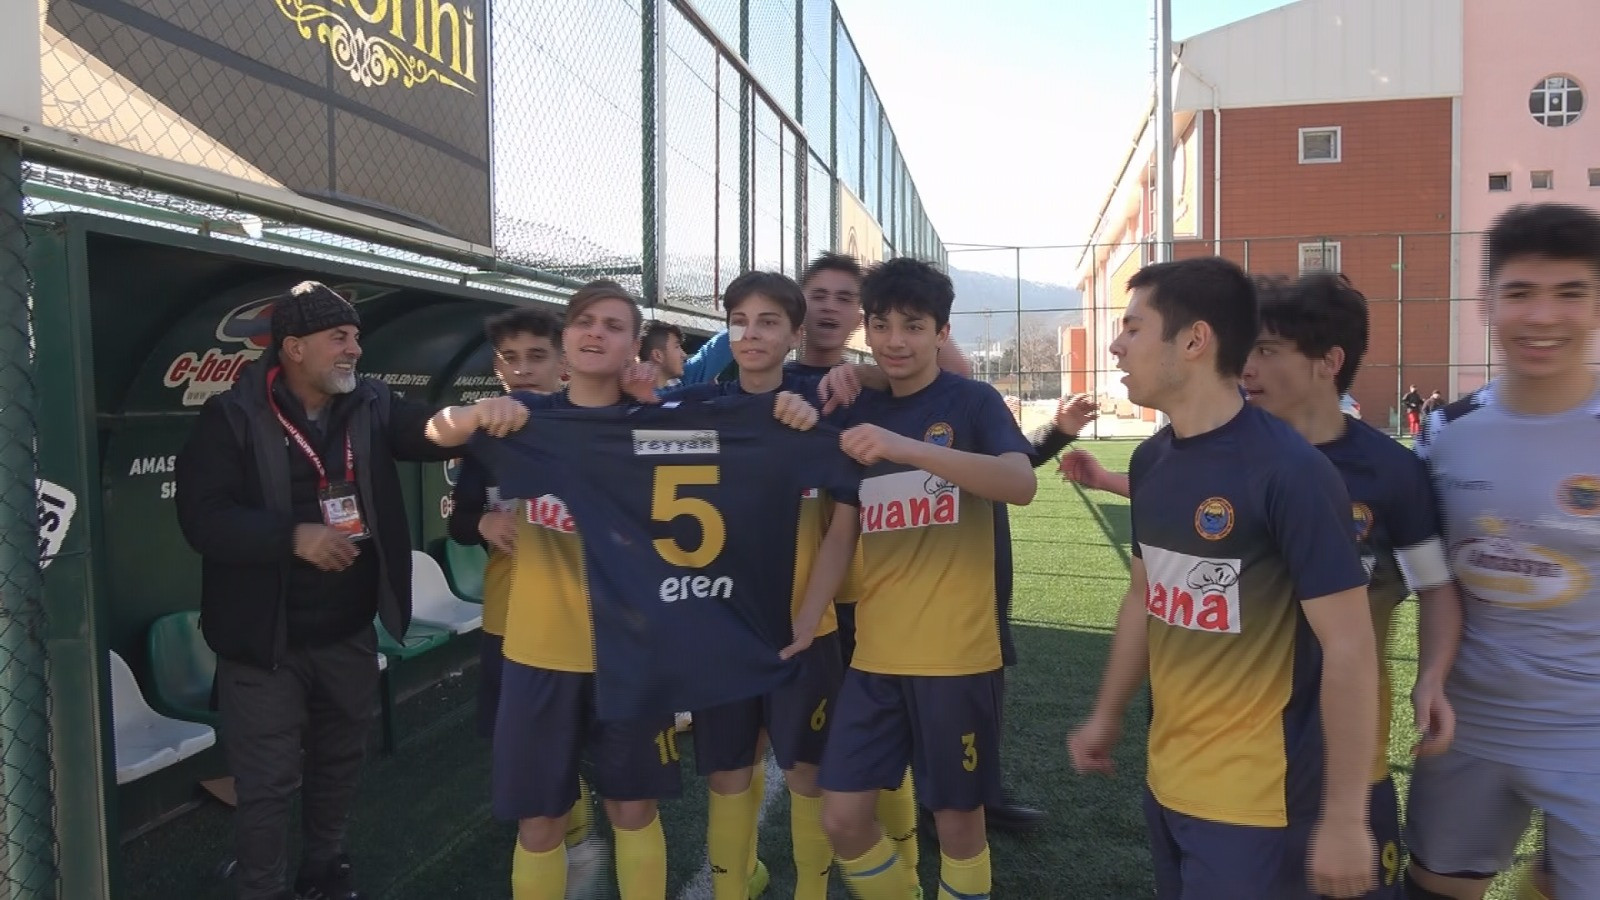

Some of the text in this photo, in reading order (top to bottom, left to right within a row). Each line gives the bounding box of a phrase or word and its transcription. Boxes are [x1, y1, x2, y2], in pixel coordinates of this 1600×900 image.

[129, 456, 176, 475] AMAS
[651, 465, 726, 568] 5
[660, 576, 733, 602] eren
[811, 698, 827, 731] 6
[962, 733, 978, 772] 3
